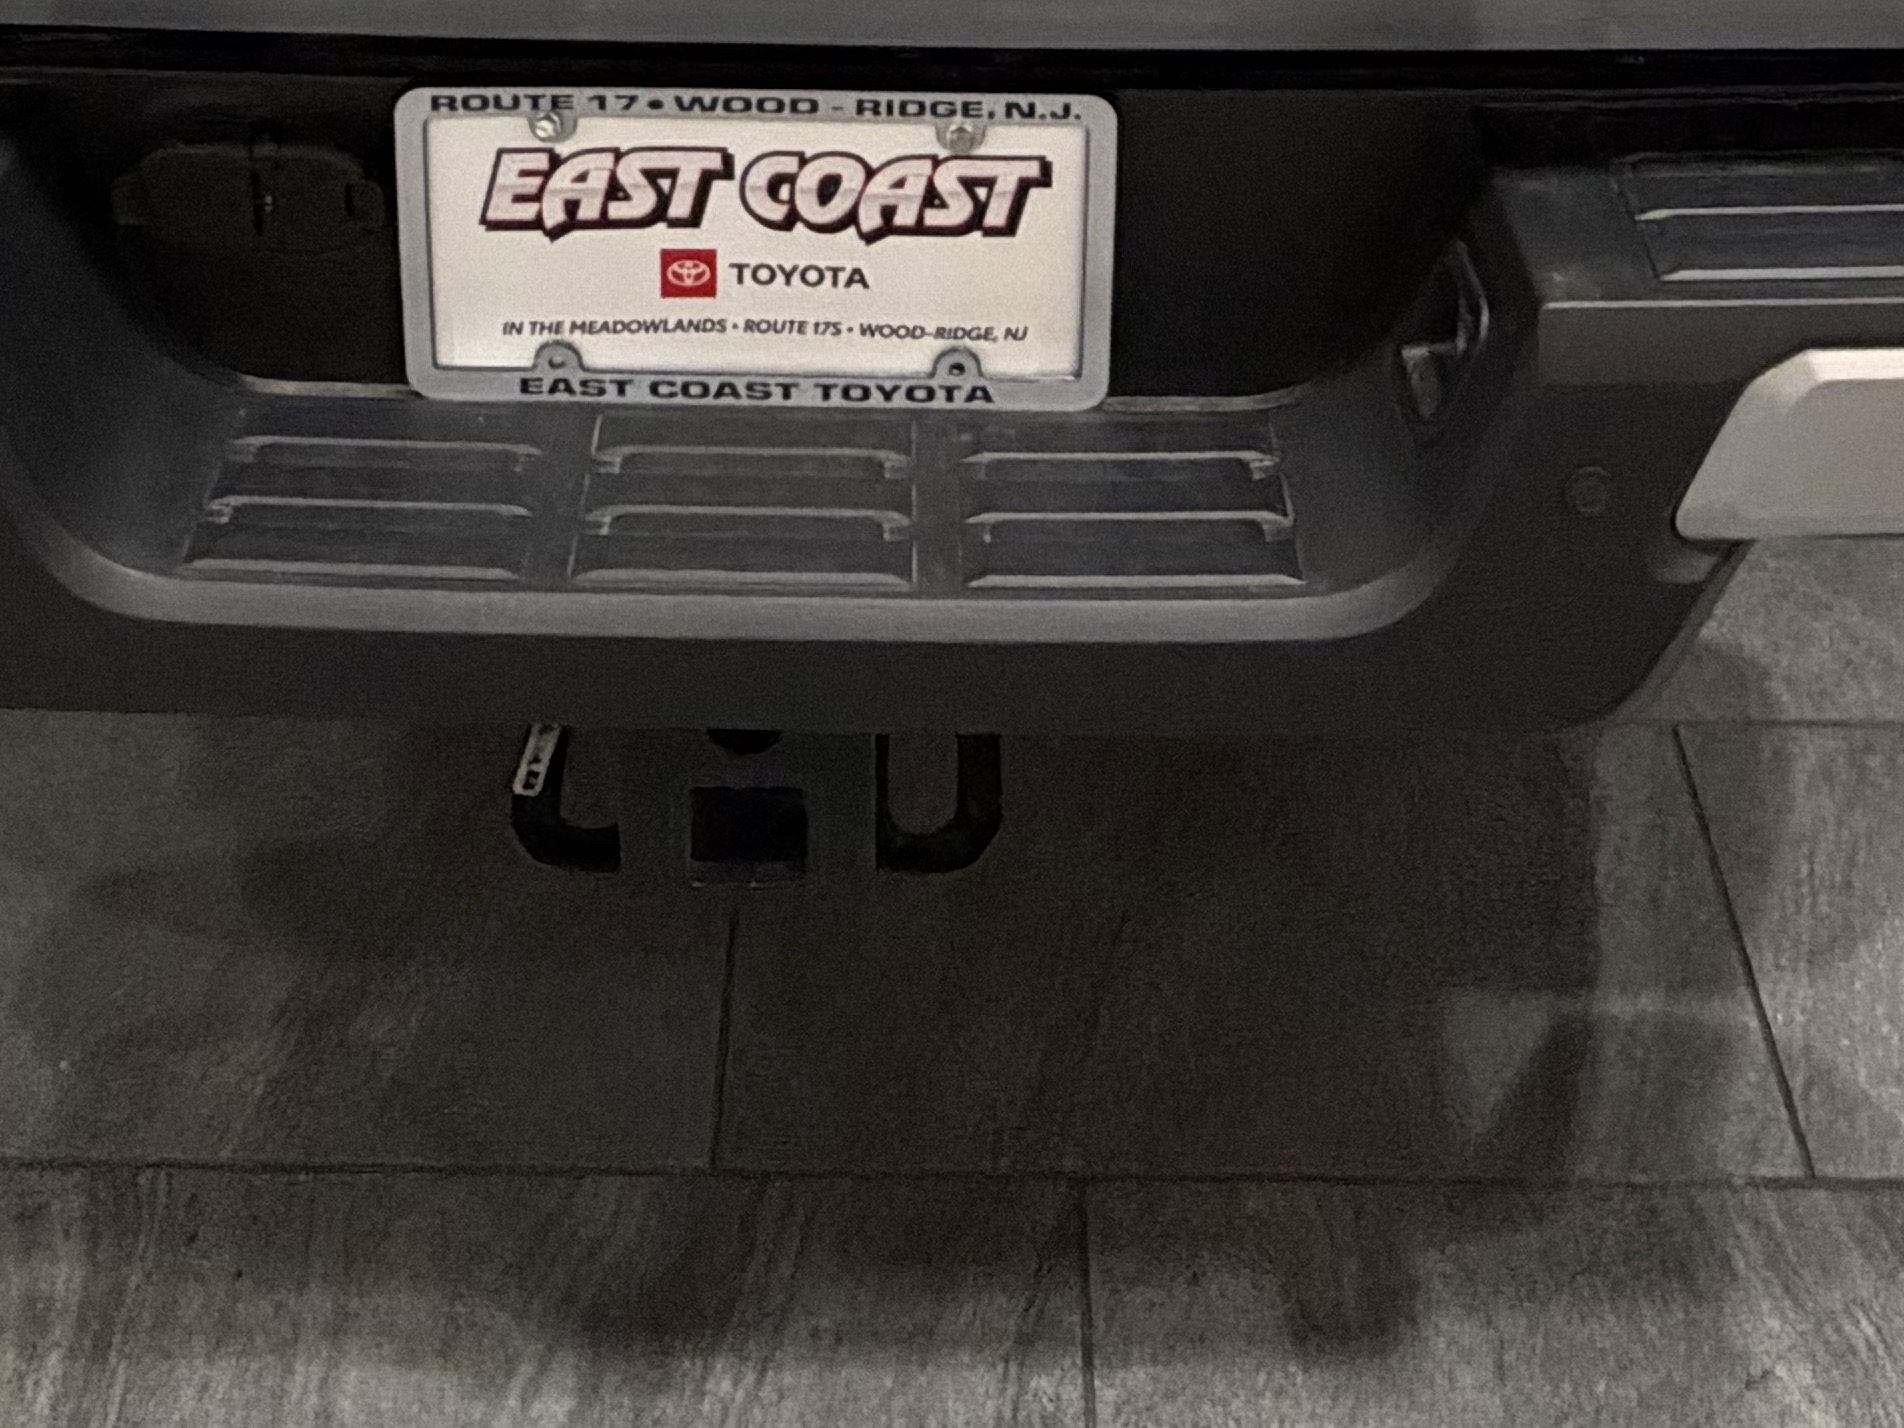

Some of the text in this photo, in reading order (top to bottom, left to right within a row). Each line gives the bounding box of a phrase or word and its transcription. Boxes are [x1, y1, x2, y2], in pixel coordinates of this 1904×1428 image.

[430, 94, 575, 112] ROUTE
[586, 94, 639, 111] 17
[673, 95, 820, 114] WOOD
[855, 99, 995, 121] RIDGE,
[1004, 102, 1082, 120] N.J.
[480, 146, 1053, 245] EAST COAST
[728, 261, 871, 291] TOYOTA
[502, 320, 524, 336] IN
[529, 320, 564, 336] THE
[568, 318, 728, 336] MEADOWLANDS
[743, 319, 809, 335] ROUTE
[1003, 326, 1029, 342] NJ
[519, 377, 995, 404] EAST COAST TOYOTA
